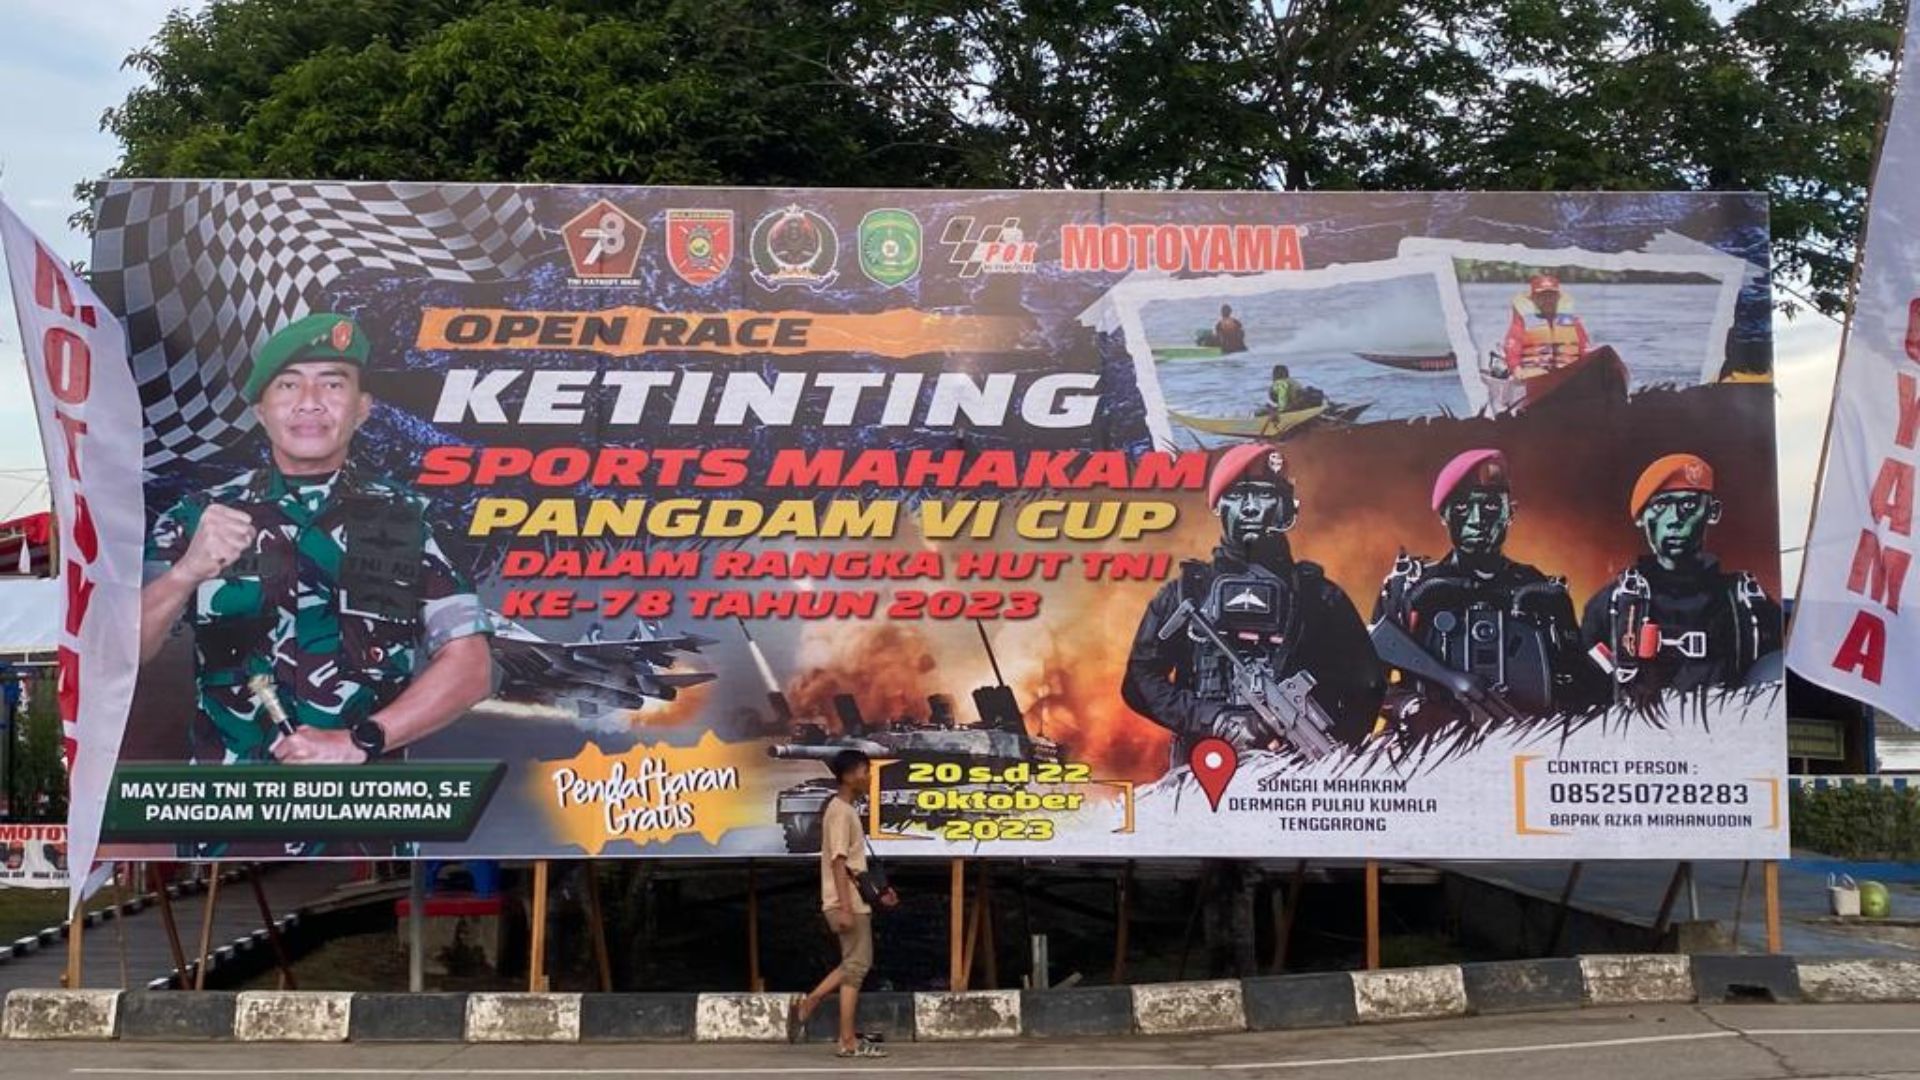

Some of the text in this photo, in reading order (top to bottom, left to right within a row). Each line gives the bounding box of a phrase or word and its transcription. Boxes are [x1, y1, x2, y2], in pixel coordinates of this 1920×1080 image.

[1061, 223, 1304, 272] MOTOYAMA
[444, 315, 812, 347] OPEN RACE
[432, 368, 1101, 428] KETINTING
[416, 447, 1207, 489] SPORTS MAHAKAM
[468, 498, 1177, 539] PANGDAM VI CUP
[503, 550, 1171, 580] DALAM RANGKA HUT TNI
[502, 591, 1042, 618] KE-78 TAHUN 2023
[908, 763, 1090, 783] 20 s.d 22
[1548, 761, 1618, 774] CONTACT
[1625, 761, 1688, 775] PERSON
[121, 781, 472, 800] MAYJEN TNI TRI BUDI UTOMO, S.E
[553, 757, 739, 808] Pendaftaran
[1258, 779, 1407, 793] SUNGAI MAHAKAM
[917, 790, 1083, 811] Oktober
[1550, 783, 1748, 804] 085250728283
[146, 802, 451, 821] PANGDAM VI/MULAWARMAN
[606, 798, 695, 834] Gratis
[1229, 798, 1437, 813] DERMAGA PULAU KUMALA
[945, 819, 1054, 841] 2023
[1279, 817, 1386, 831] TENGGARONG
[1550, 814, 1752, 828] BAPAK AZKA MIRHANUDDIN
